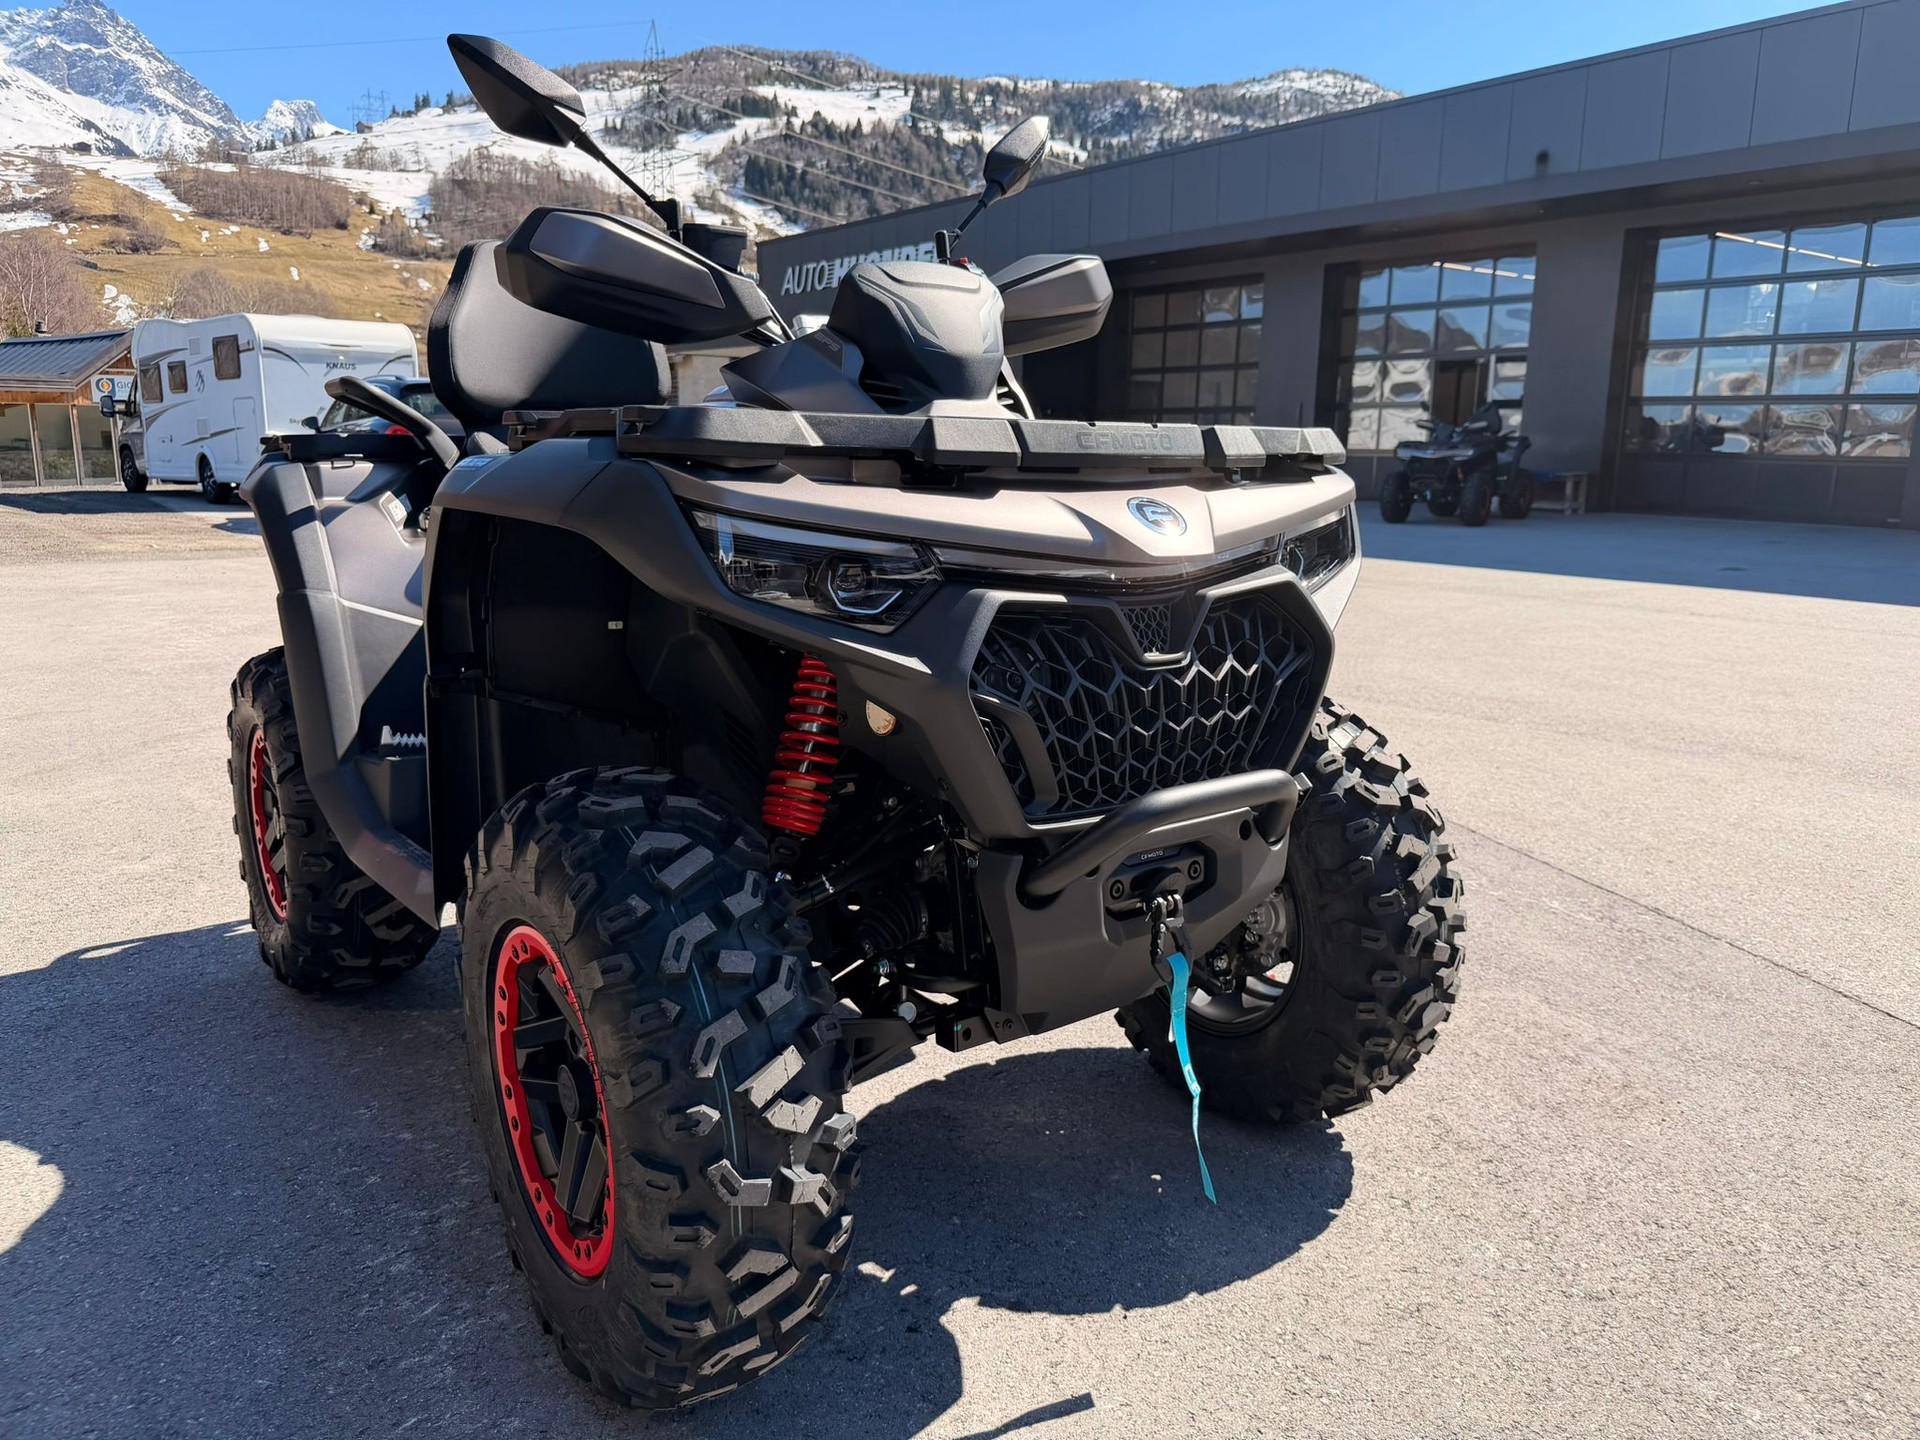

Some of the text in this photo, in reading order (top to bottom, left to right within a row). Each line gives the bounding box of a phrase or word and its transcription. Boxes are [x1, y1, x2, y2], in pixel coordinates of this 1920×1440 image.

[781, 261, 827, 296] AUTO
[815, 332, 841, 352] EPS
[326, 361, 357, 370] KNAUS
[1076, 431, 1173, 450] CFMOTO
